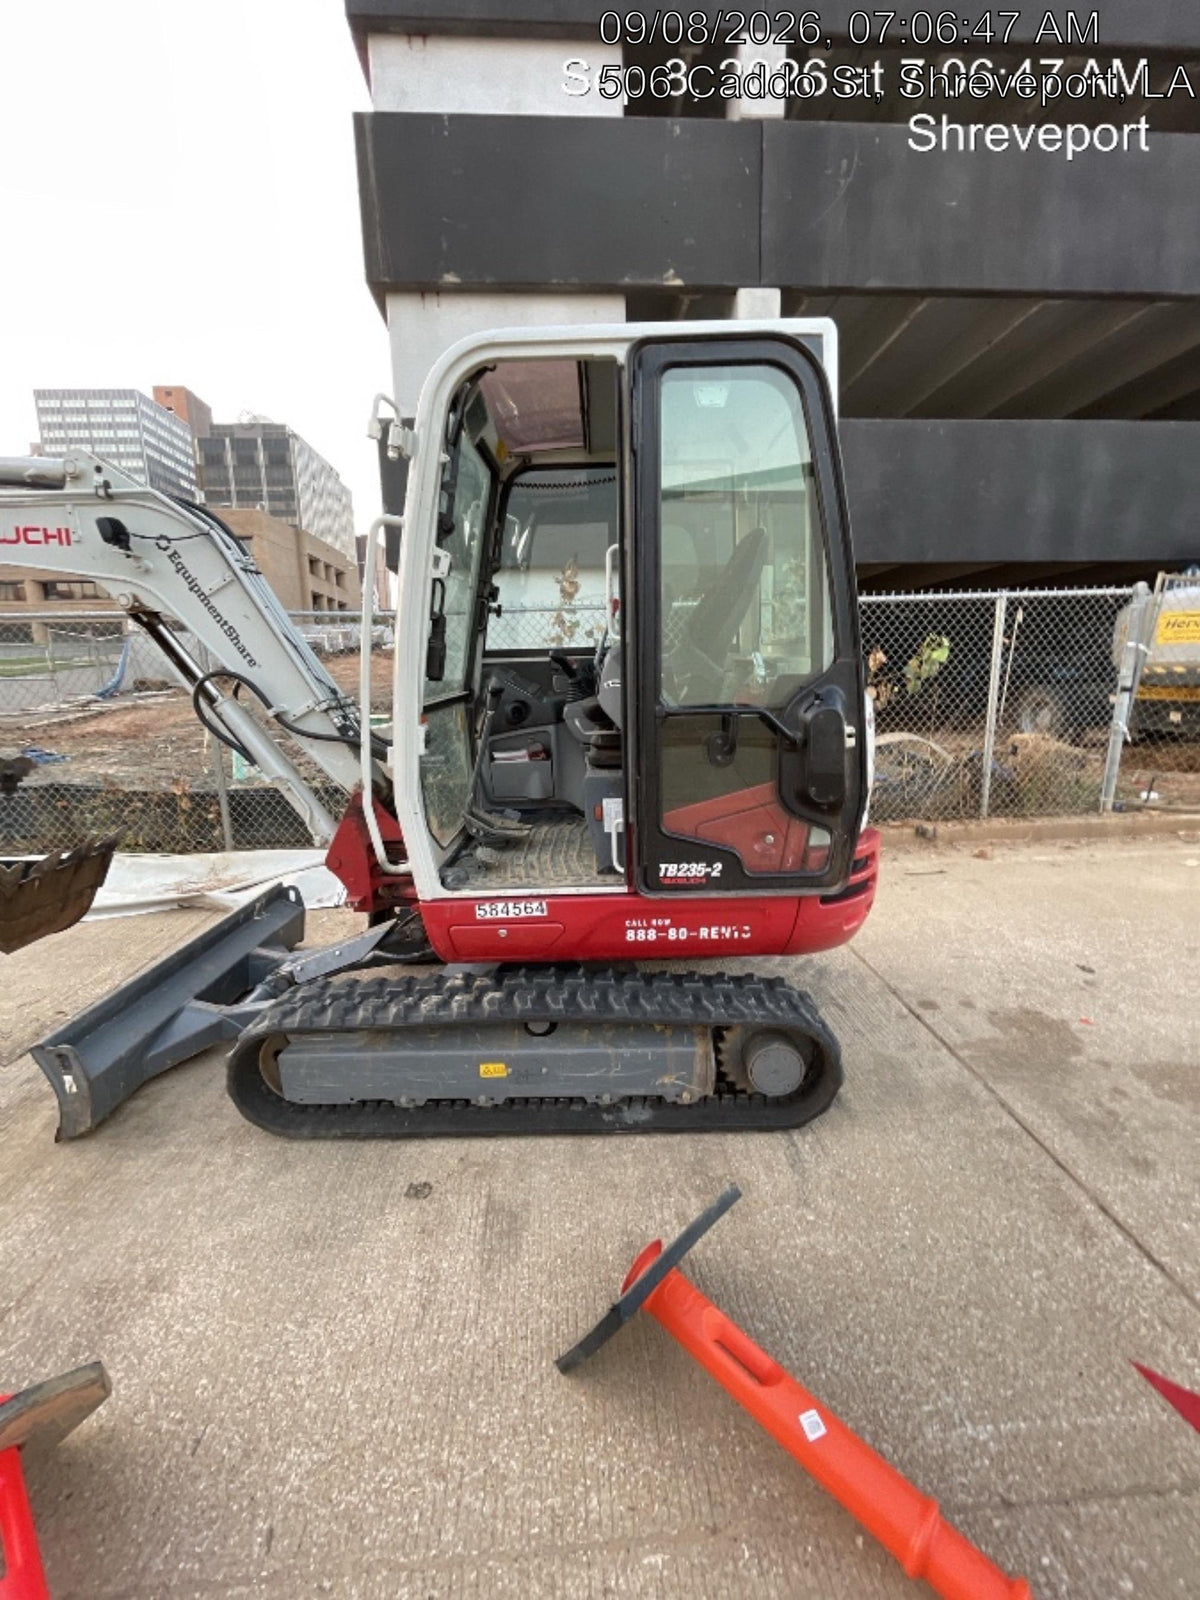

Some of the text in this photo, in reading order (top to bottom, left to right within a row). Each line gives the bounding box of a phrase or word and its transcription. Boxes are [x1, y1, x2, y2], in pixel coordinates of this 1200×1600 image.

[167, 549, 257, 668] EquipmentShare
[658, 862, 723, 878] TB235-2
[477, 902, 546, 918] 584564
[625, 919, 648, 927] CALL
